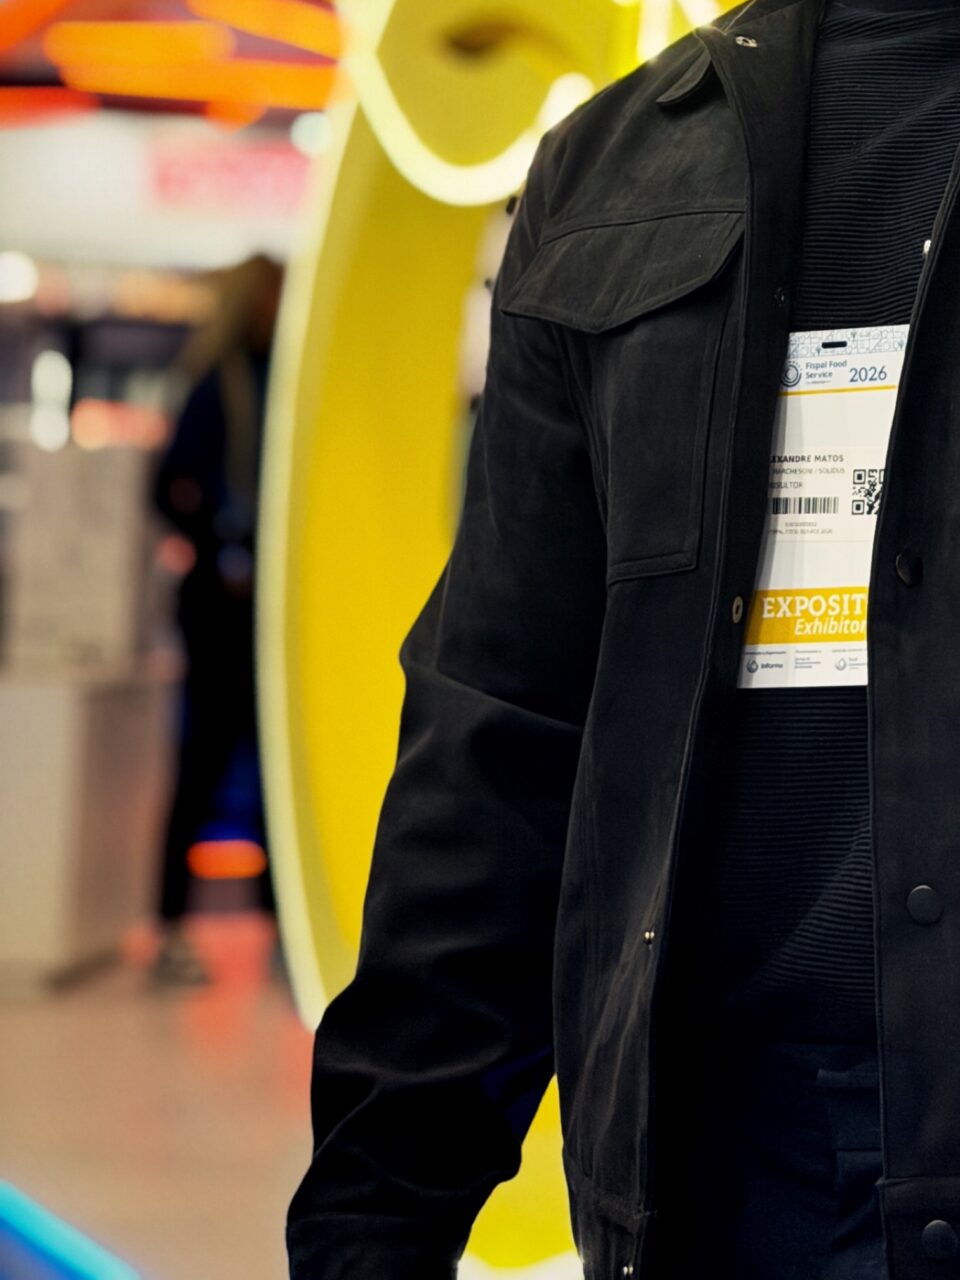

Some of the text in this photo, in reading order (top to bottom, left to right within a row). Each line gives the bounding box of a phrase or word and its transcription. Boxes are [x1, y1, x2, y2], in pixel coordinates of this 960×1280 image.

[806, 360, 847, 370] Fispal Food
[806, 370, 833, 379] Service
[850, 366, 887, 382] 2026
[814, 454, 844, 463] MATOS
[762, 593, 867, 619] EXPOSIT
